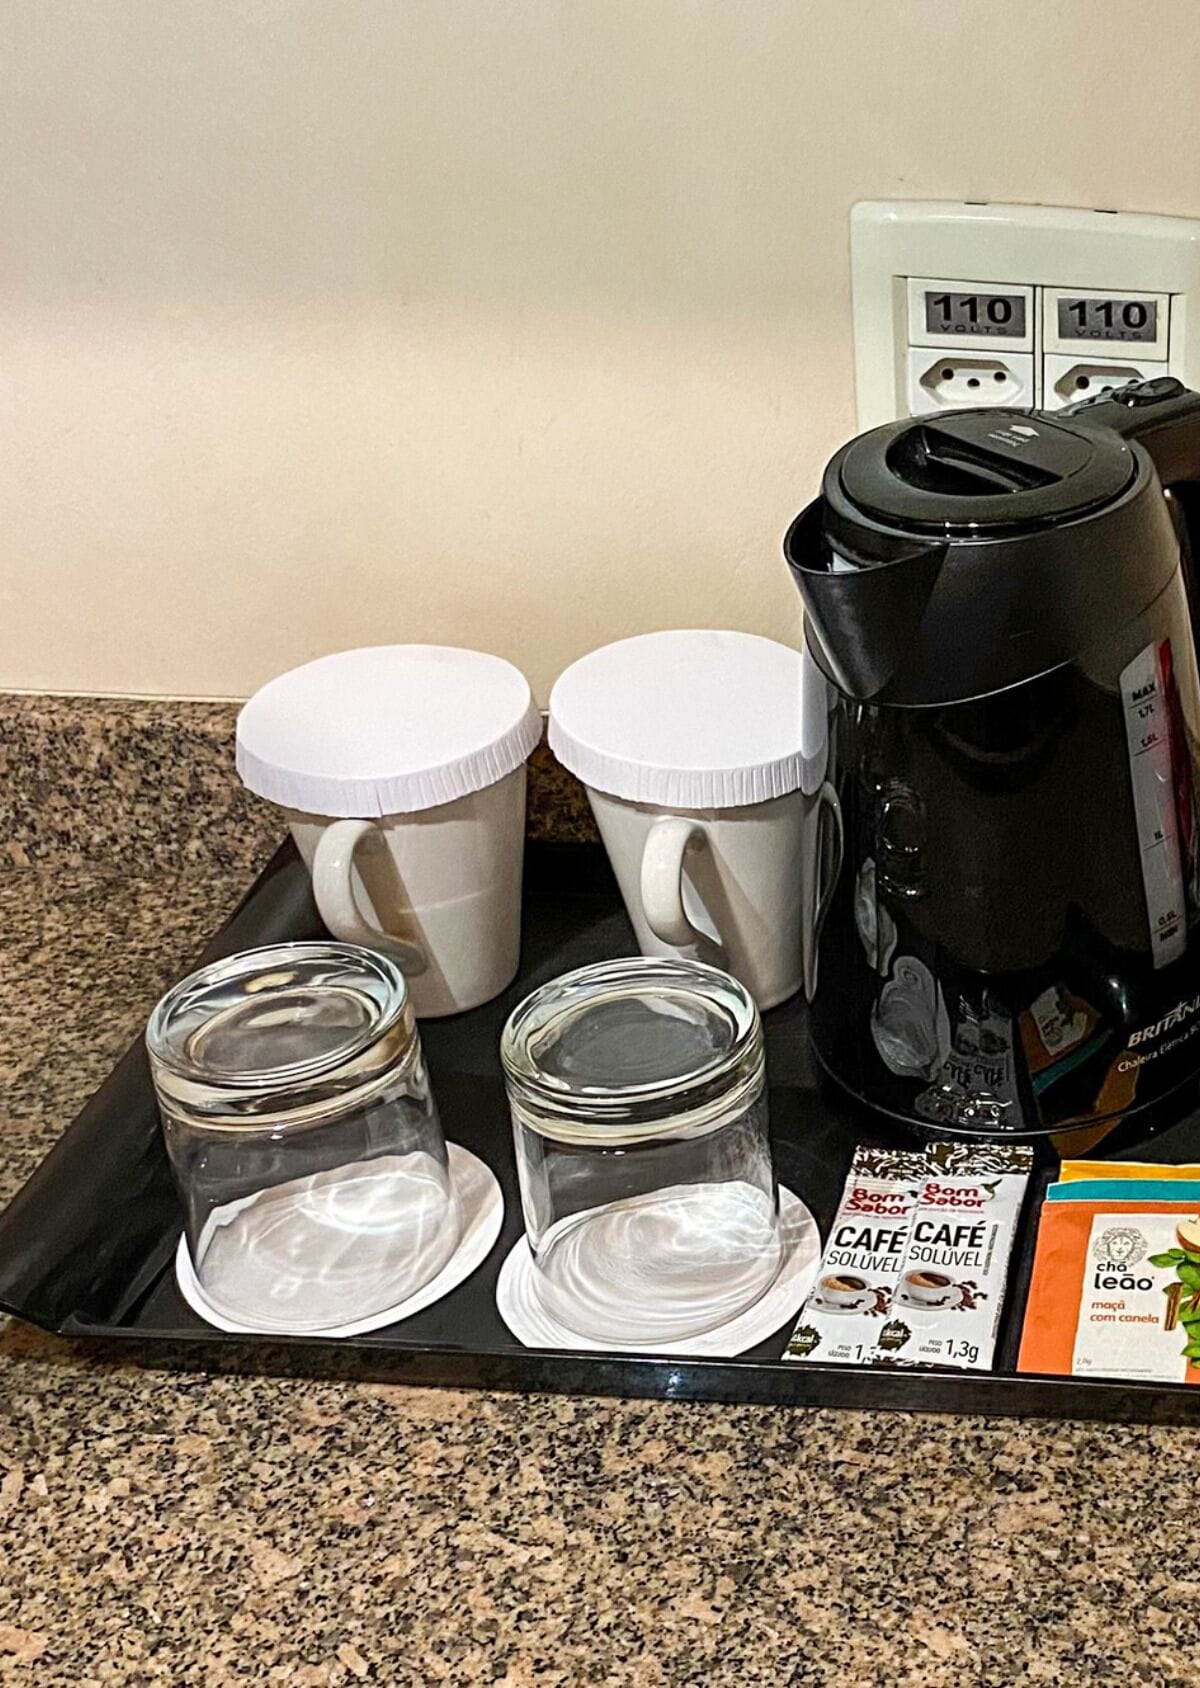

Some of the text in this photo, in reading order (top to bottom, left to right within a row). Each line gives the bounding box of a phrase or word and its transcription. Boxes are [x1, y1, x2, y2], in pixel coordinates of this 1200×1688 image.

[934, 295, 1012, 325] 110
[1068, 300, 1147, 329] 110
[940, 324, 1007, 335] VOLTS
[1075, 330, 1142, 340] VOLTS
[1132, 682, 1155, 701] MAX
[853, 1188, 905, 1203] Bom
[925, 1183, 979, 1197] Bom
[845, 1200, 912, 1216] Sabor
[919, 1193, 987, 1208] Sabor
[834, 1226, 908, 1254] CAFÉ
[914, 1221, 986, 1248] CAFÉ
[827, 1251, 901, 1273] SOLÚVEL
[908, 1246, 983, 1267] SOLÚVEL
[1097, 1261, 1127, 1273] chá
[1094, 1273, 1153, 1291] leão
[1091, 1300, 1125, 1312] maçã
[1090, 1312, 1159, 1324] com canela
[946, 1339, 979, 1363] 1,3g
